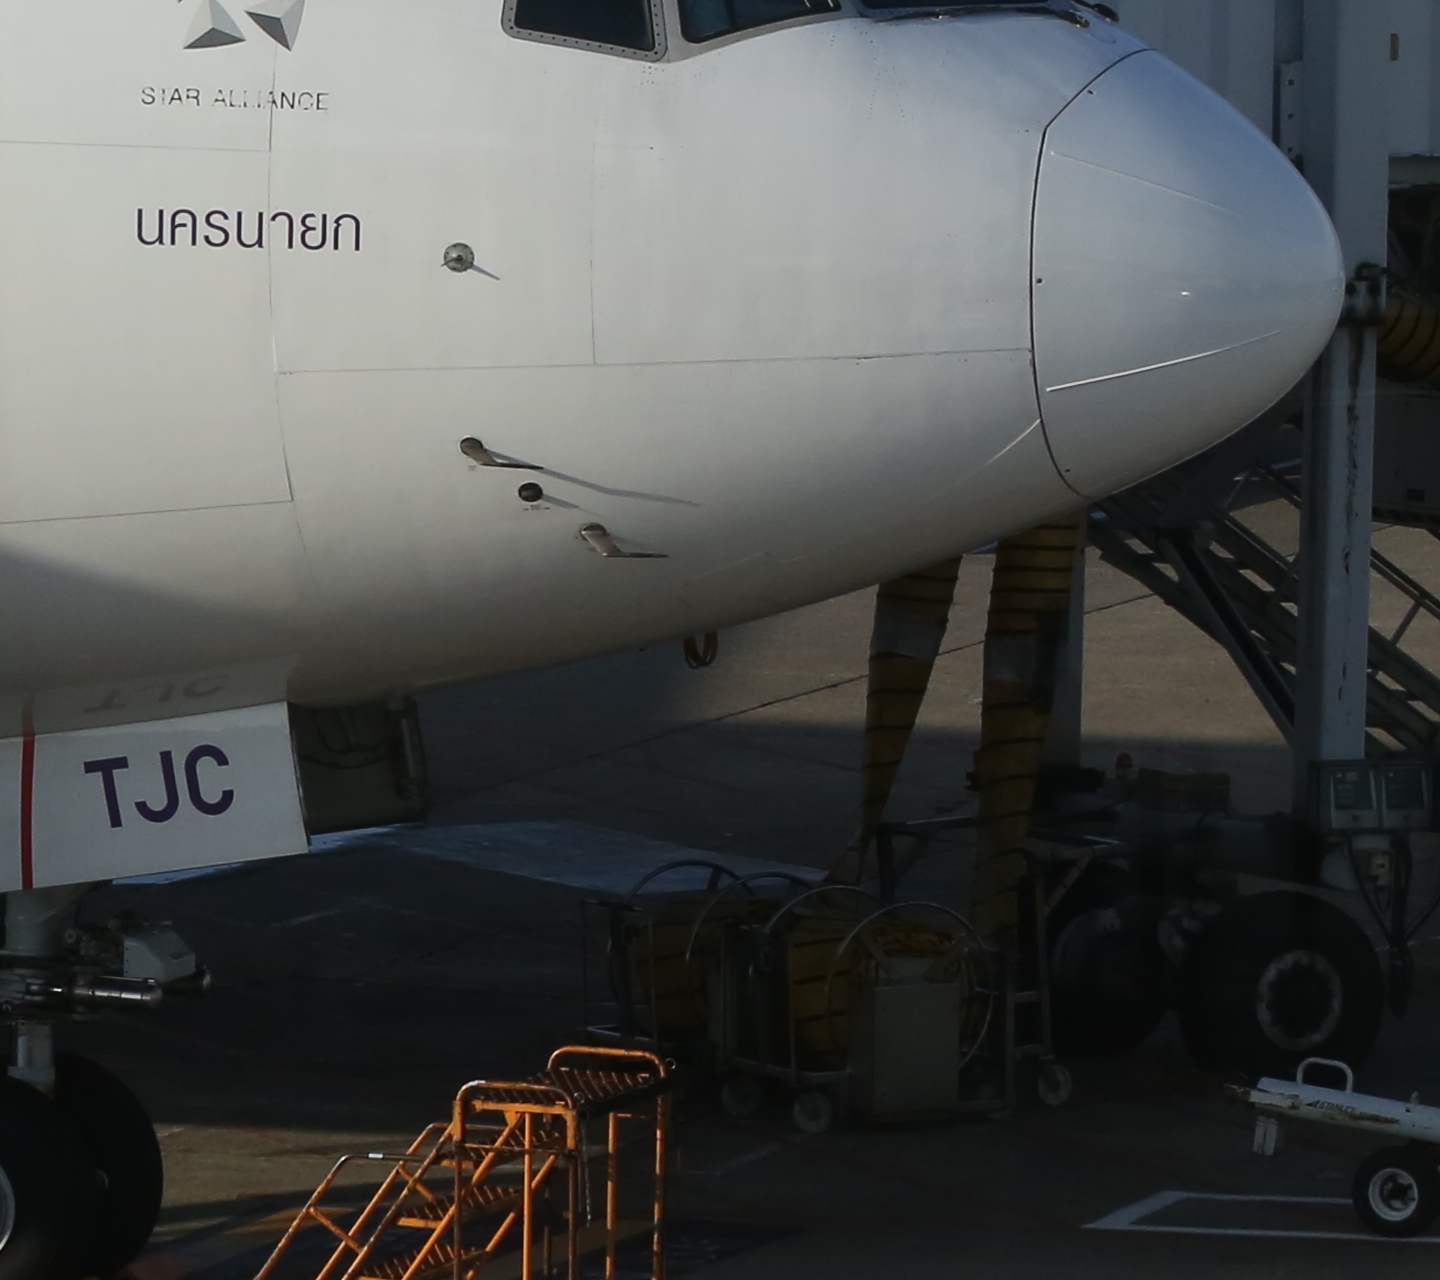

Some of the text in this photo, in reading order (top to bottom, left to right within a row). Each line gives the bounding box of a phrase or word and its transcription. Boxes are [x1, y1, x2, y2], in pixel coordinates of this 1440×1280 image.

[140, 86, 330, 111] STAR ALLIANCE
[136, 207, 361, 252] นครนายก
[83, 744, 235, 829] TJC
